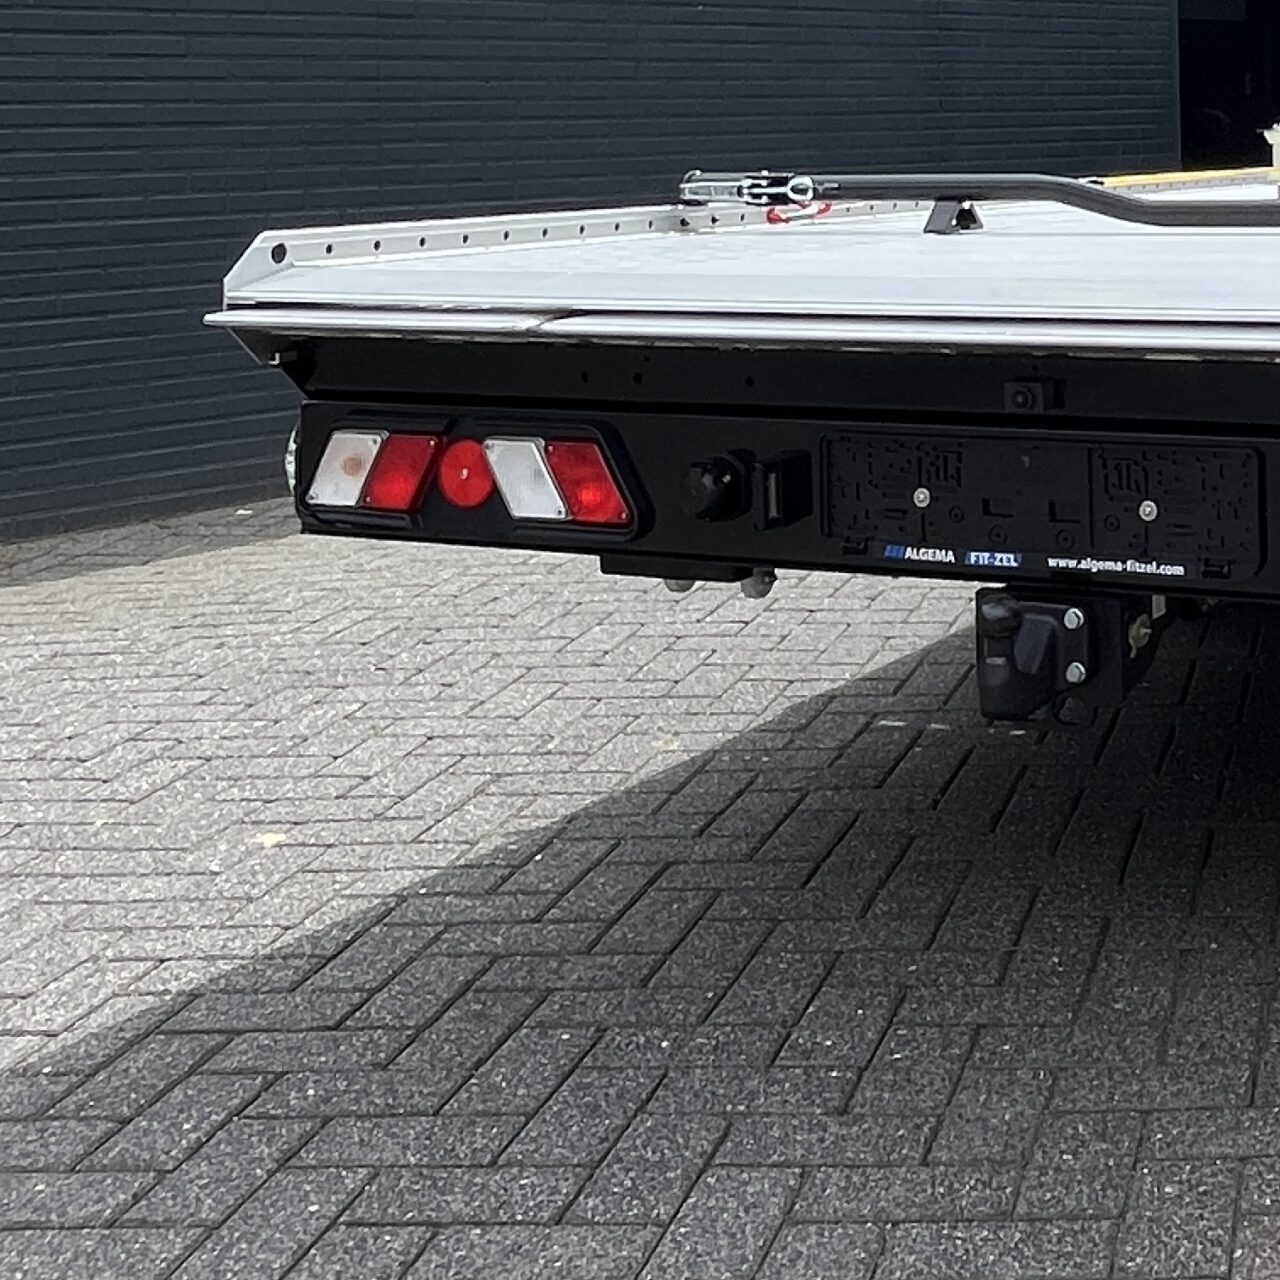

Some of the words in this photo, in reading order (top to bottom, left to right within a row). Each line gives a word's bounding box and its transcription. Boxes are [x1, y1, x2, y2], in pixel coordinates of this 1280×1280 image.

[904, 546, 956, 563] ALGEMA
[969, 551, 1019, 567] FIT-ZEL
[1047, 557, 1185, 576] www.algema-fitzel.com
